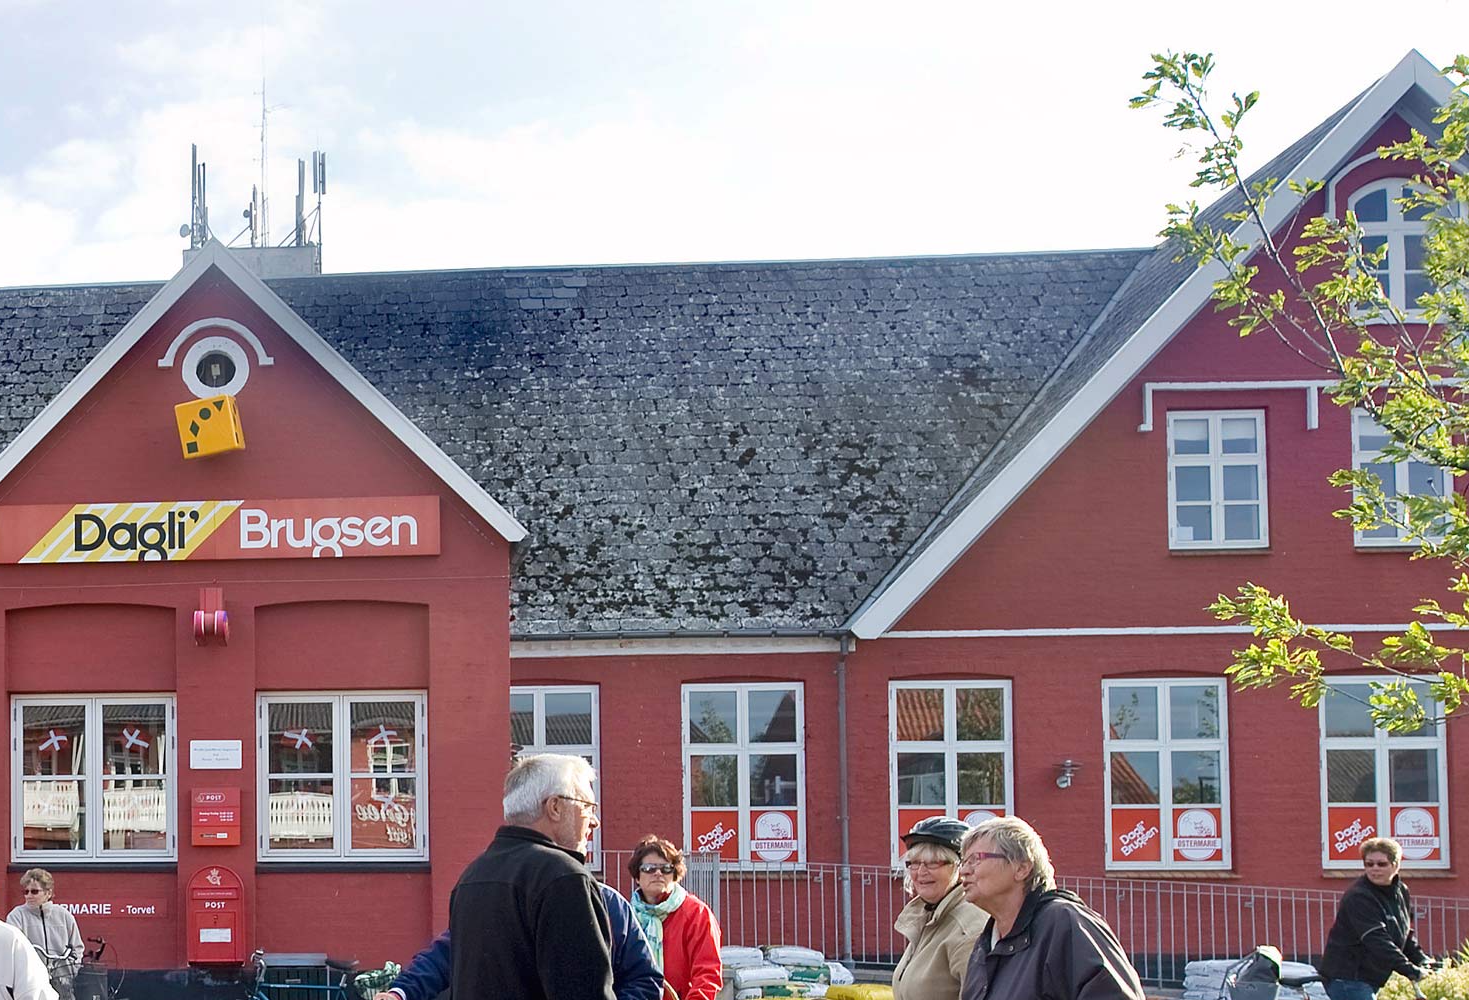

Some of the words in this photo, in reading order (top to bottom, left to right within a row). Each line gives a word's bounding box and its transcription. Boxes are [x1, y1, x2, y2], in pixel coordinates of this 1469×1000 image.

[73, 510, 200, 561] Dagli'
[240, 508, 418, 558] Brugsen
[126, 905, 155, 914] Torvet
[204, 901, 226, 909] POST
